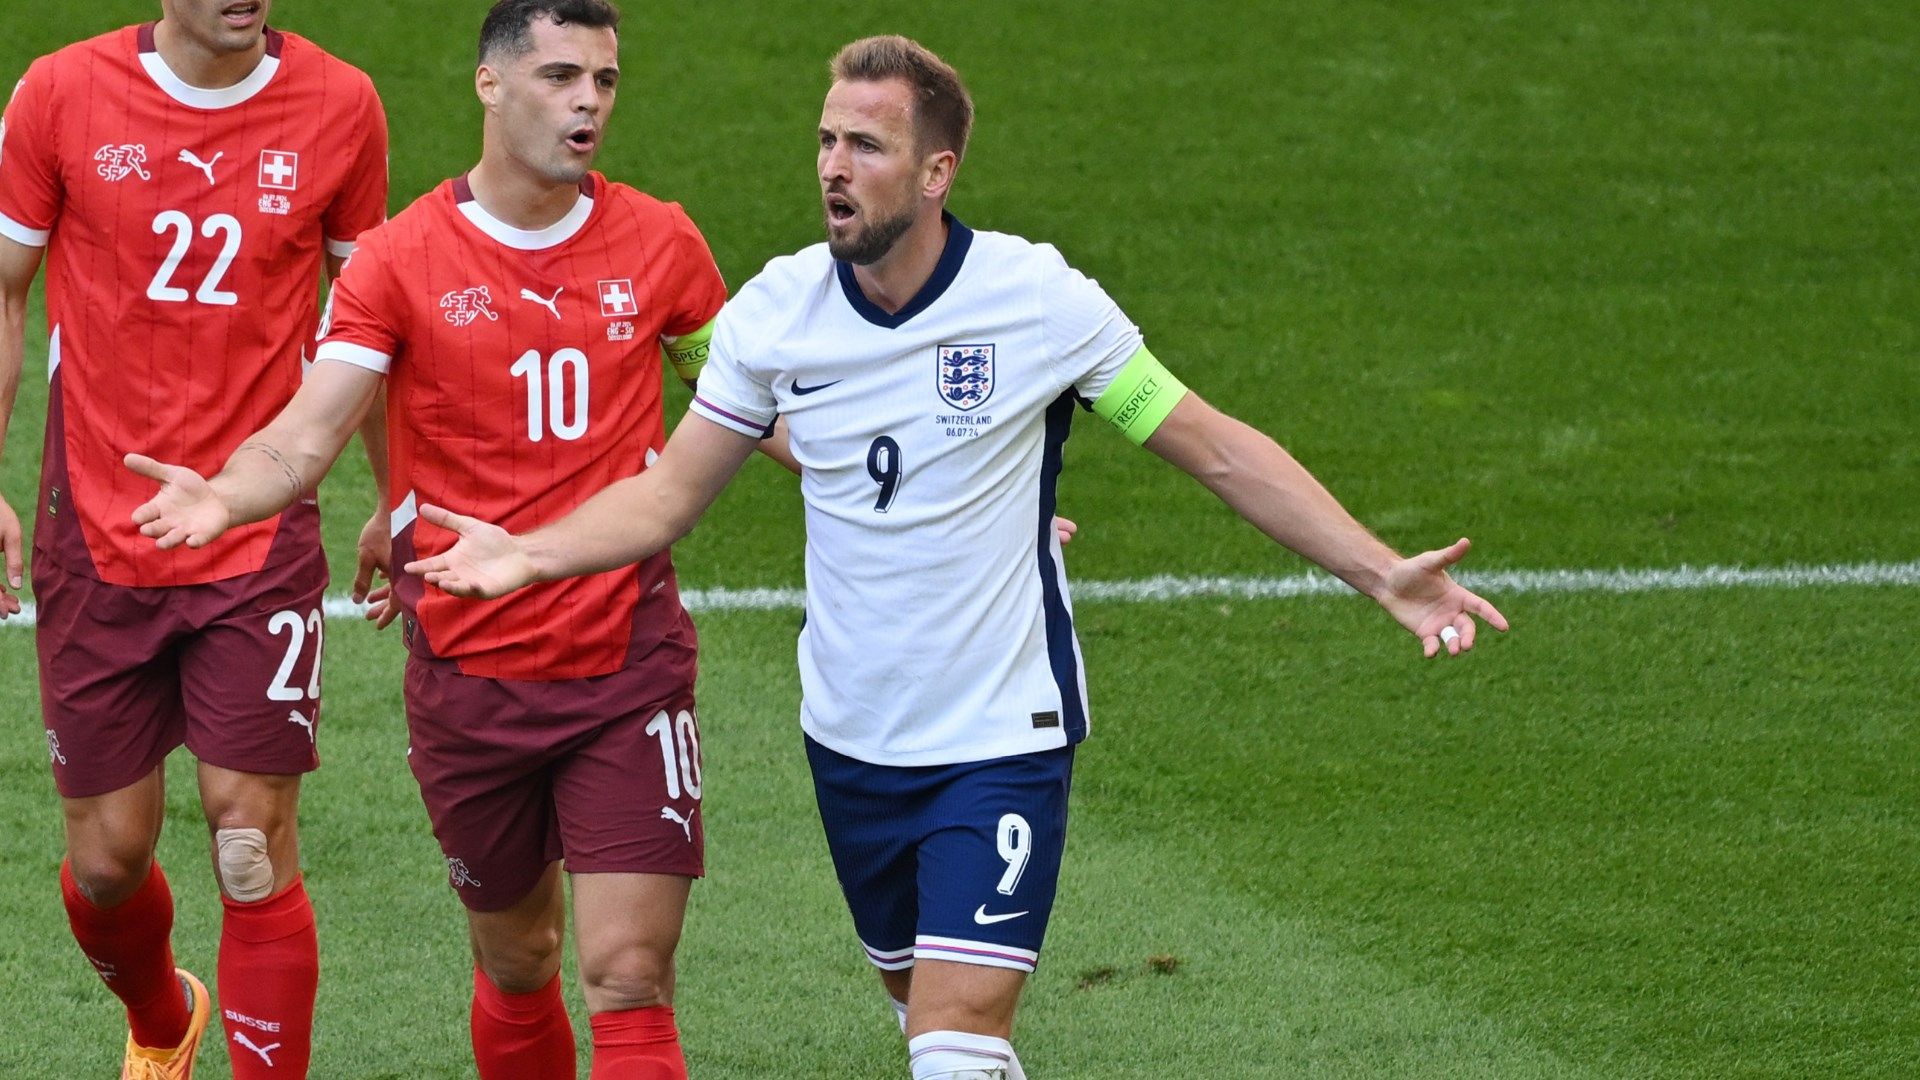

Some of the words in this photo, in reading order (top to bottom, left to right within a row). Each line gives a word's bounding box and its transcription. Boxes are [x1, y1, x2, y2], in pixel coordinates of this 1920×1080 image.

[147, 210, 242, 305] 22
[510, 348, 589, 443] 10
[935, 414, 992, 425] SWITZERLAND
[946, 427, 979, 437] 06.0724
[1117, 377, 1158, 426] RESPECT
[866, 435, 903, 514] 9
[266, 608, 323, 701] 22
[645, 709, 702, 800] 10
[996, 813, 1032, 896] 9
[225, 1009, 280, 1033] SUISSE
